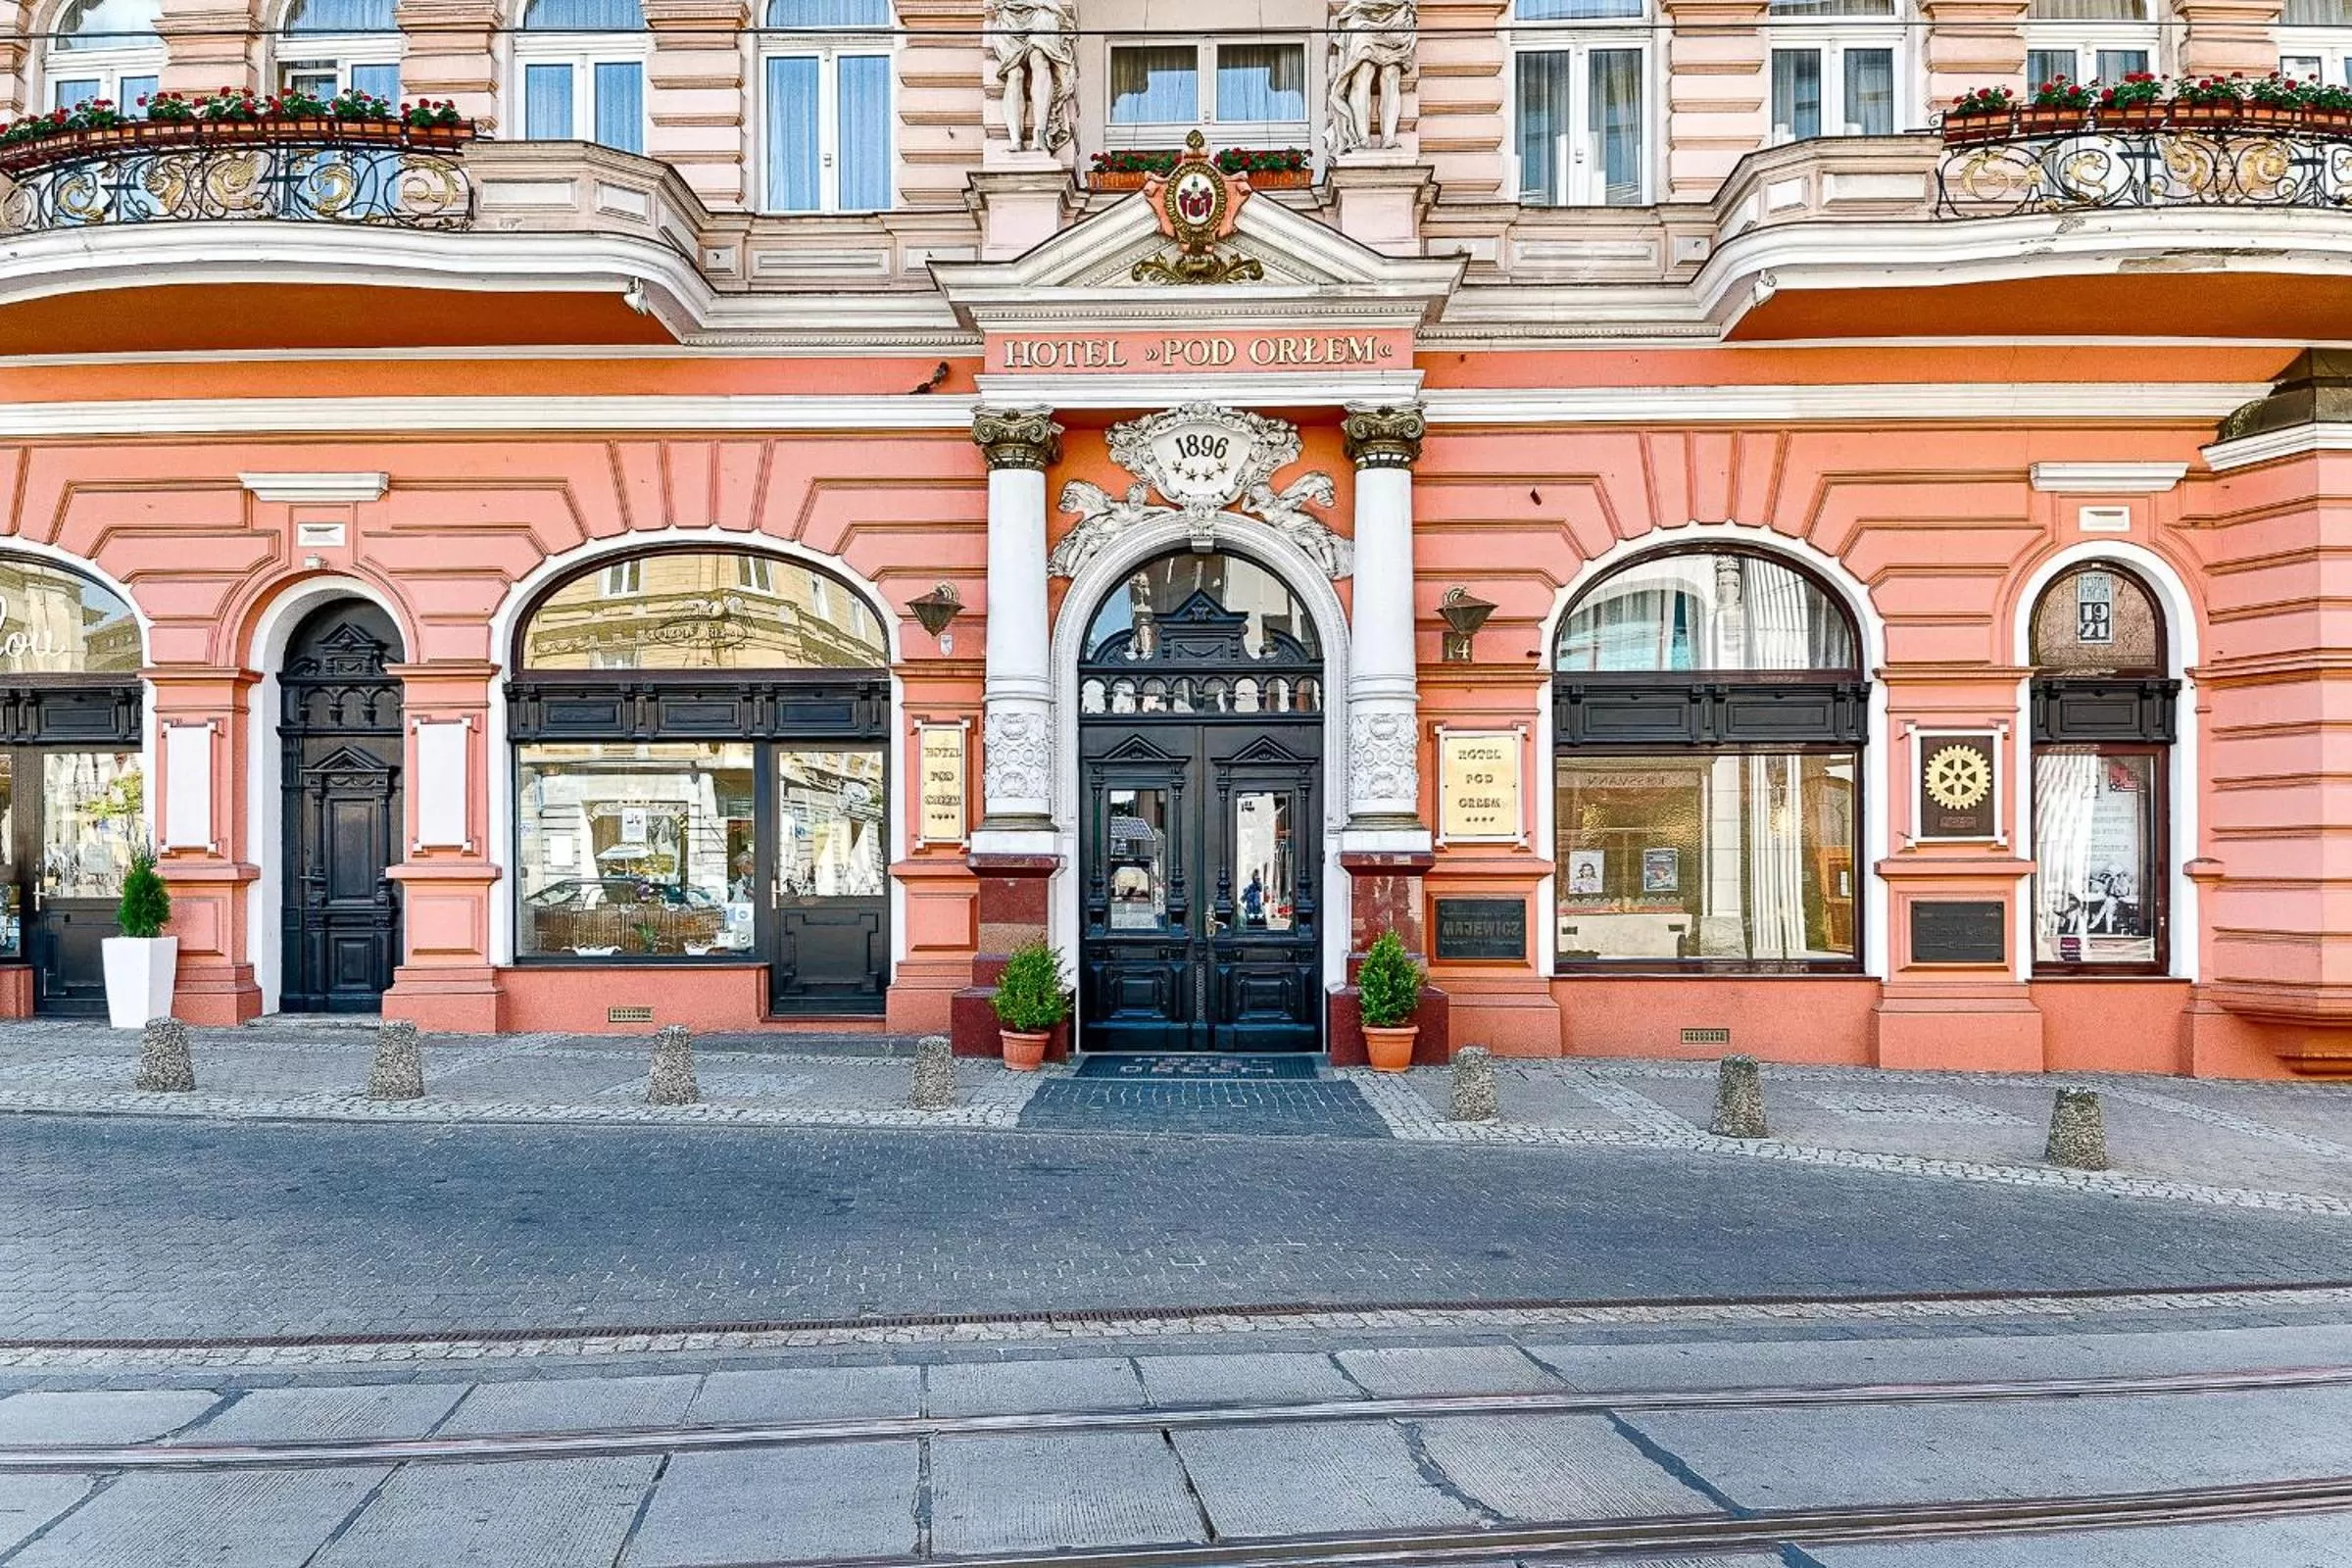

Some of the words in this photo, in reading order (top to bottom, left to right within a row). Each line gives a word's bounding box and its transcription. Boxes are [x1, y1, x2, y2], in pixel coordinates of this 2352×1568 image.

[1004, 339, 1127, 368] HOTEL
[1175, 433, 1229, 460] 1896
[2082, 603, 2108, 621] 19
[2081, 621, 2108, 638] 21
[1446, 636, 1470, 660] 14
[1458, 749, 1501, 760] HOTEL
[930, 771, 955, 781] POD
[1466, 773, 1494, 784] POD
